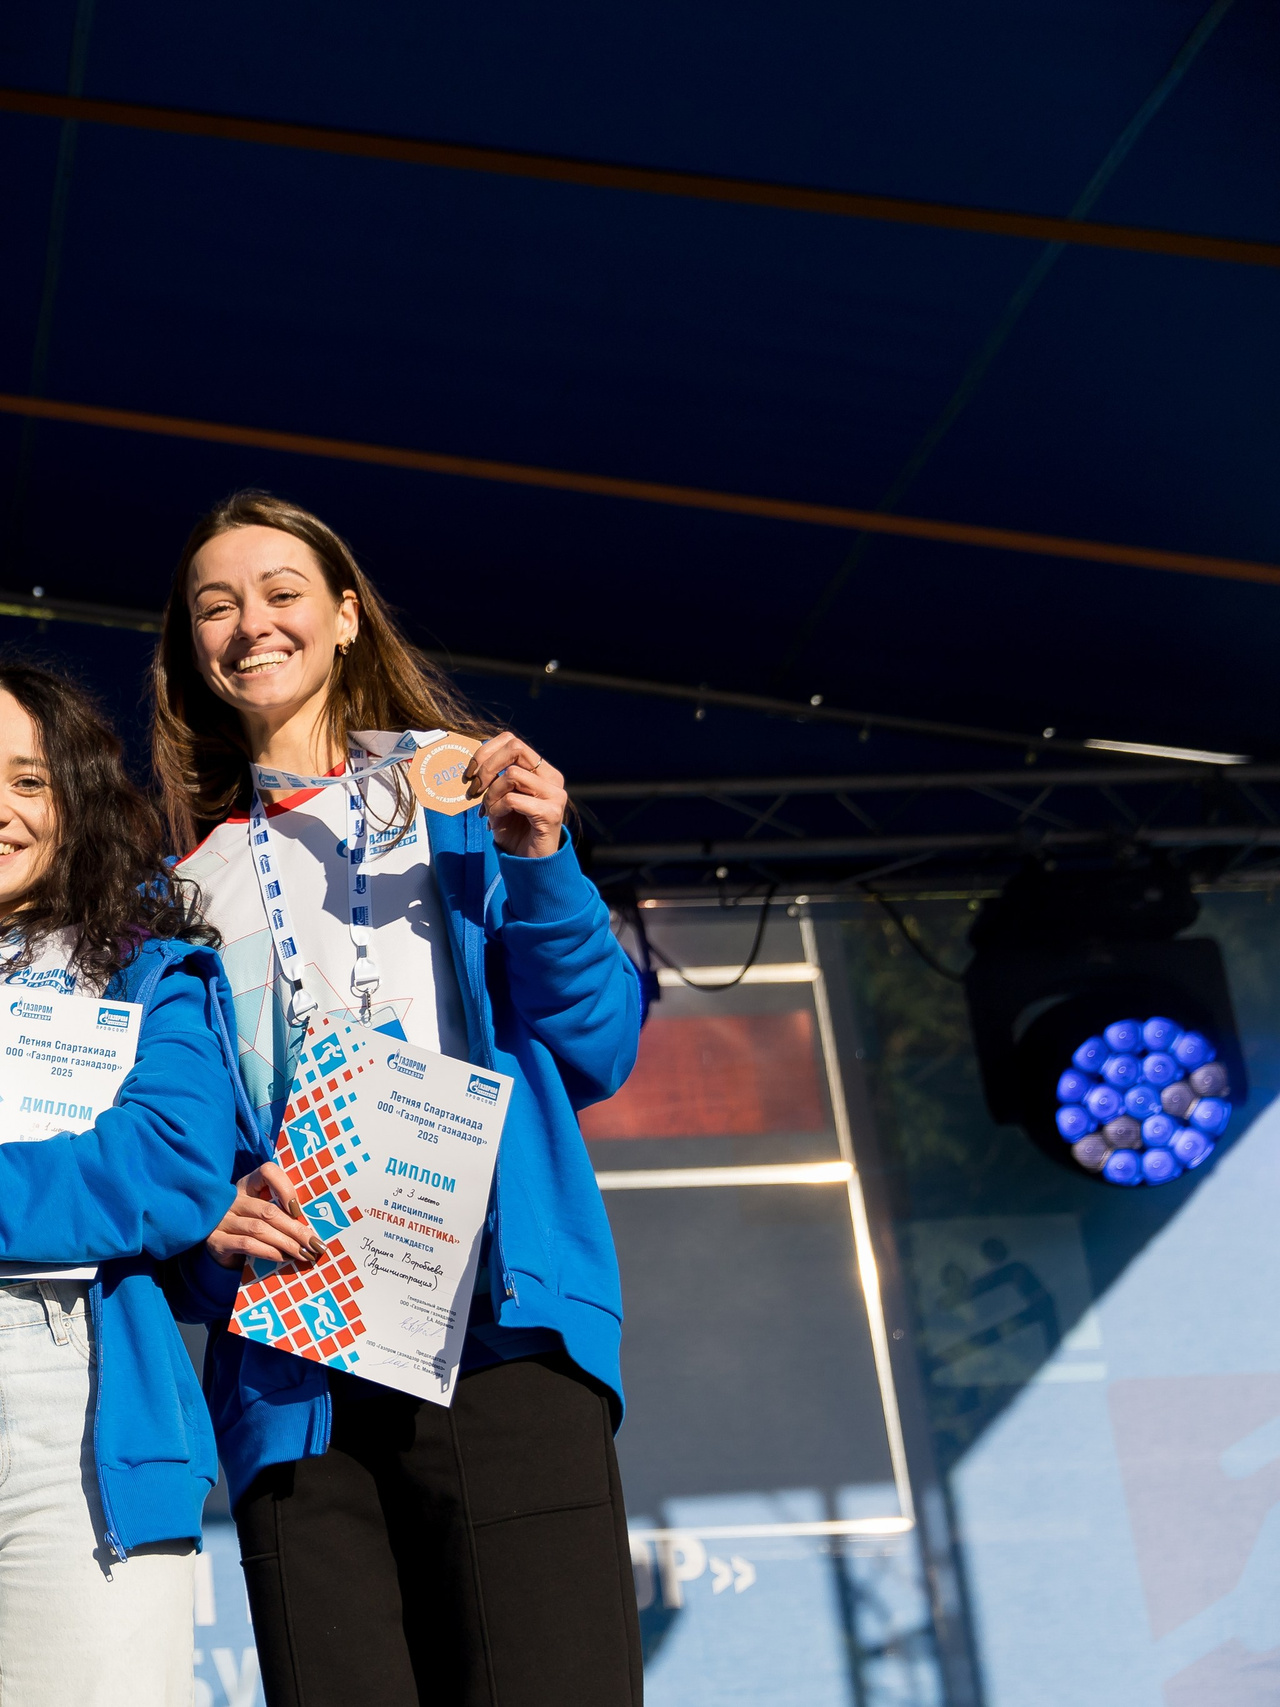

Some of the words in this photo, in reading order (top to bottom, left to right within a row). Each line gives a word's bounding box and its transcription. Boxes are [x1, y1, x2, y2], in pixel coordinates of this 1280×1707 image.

[433, 761, 467, 786] 2025
[369, 820, 417, 845] АЗПРОМ
[23, 1001, 53, 1014] ГАЗПРОМ
[18, 1035, 52, 1048] Летняя
[55, 1040, 117, 1058] Спартакиада
[6, 1046, 24, 1057] ООО
[26, 1050, 68, 1064] «Газпром
[71, 1057, 123, 1072] газнадзор»
[399, 1055, 427, 1072] ГАЗПРОМ
[51, 1066, 73, 1078] 2025
[20, 1096, 93, 1121] ДИПЛОМ
[390, 1090, 422, 1109] Летняя
[423, 1102, 483, 1131] Спартакиада
[377, 1100, 394, 1114] ООО
[396, 1108, 435, 1129] «Газпром
[437, 1123, 488, 1146] газнадзор»
[417, 1129, 439, 1144] 2025
[385, 1156, 456, 1193] ДИПЛОМ
[392, 1187, 403, 1196] за
[407, 1188, 415, 1198] 3
[417, 1195, 440, 1206] место
[391, 1201, 444, 1225] дисциплине
[364, 1207, 406, 1228] «ЛЕГКАЯ
[407, 1220, 460, 1245] АТЛЕТИКА»
[360, 1236, 394, 1258] Карина
[383, 1231, 434, 1253] НАГРАЖДАЕТСЯ
